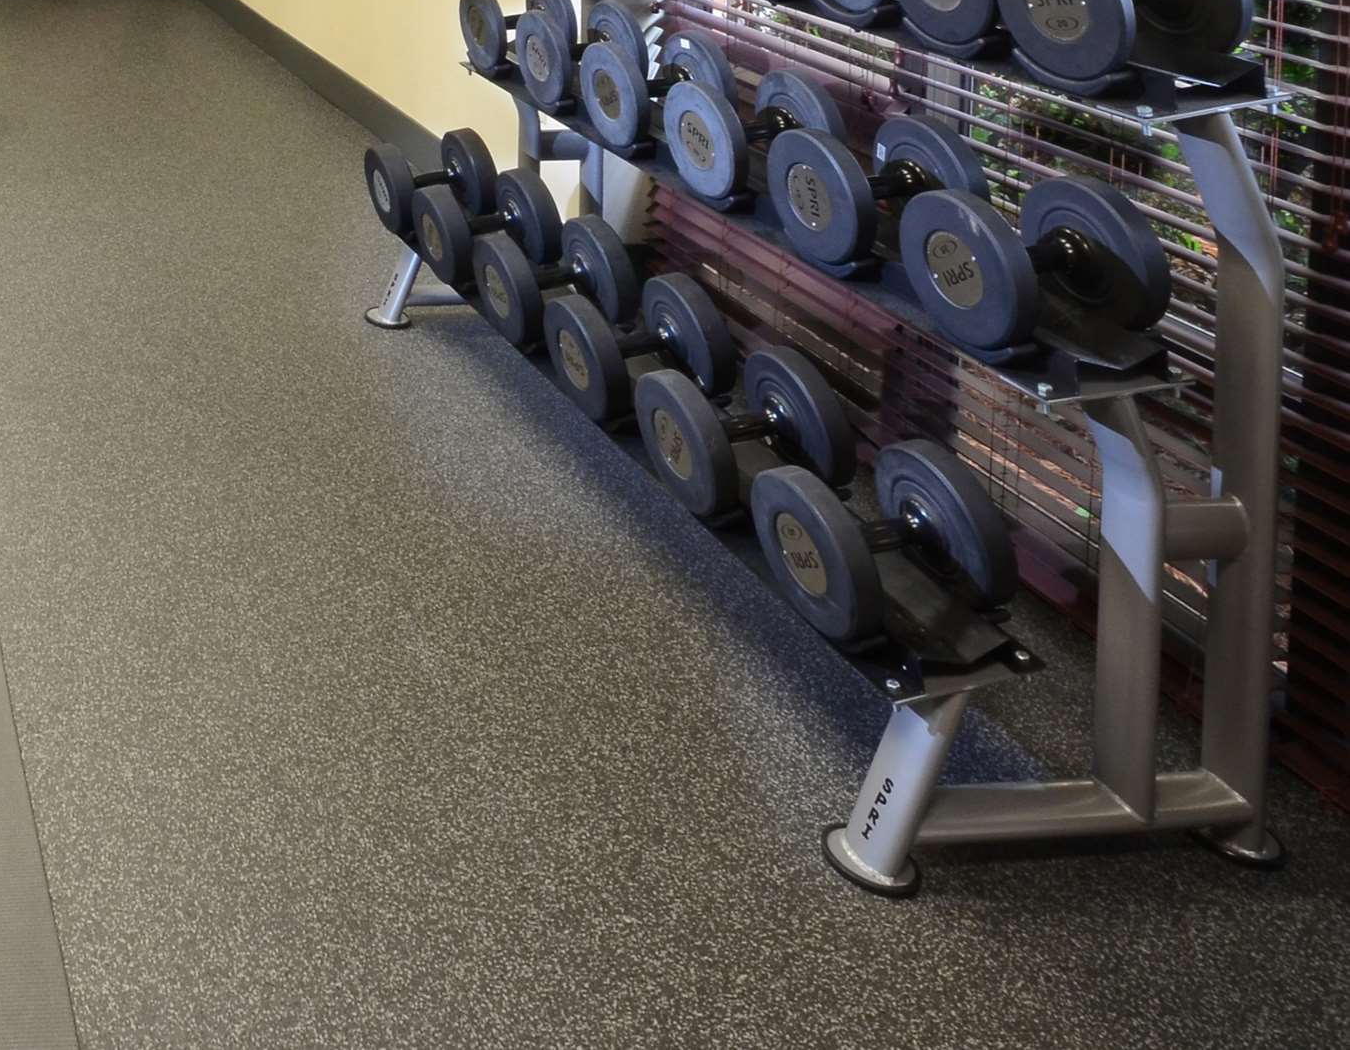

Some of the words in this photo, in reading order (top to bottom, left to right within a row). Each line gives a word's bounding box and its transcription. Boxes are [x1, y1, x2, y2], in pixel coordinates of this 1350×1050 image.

[687, 122, 710, 150] SPRI
[805, 174, 820, 218] SPRI
[942, 262, 975, 288] SPRI
[861, 778, 894, 840] SPRI
